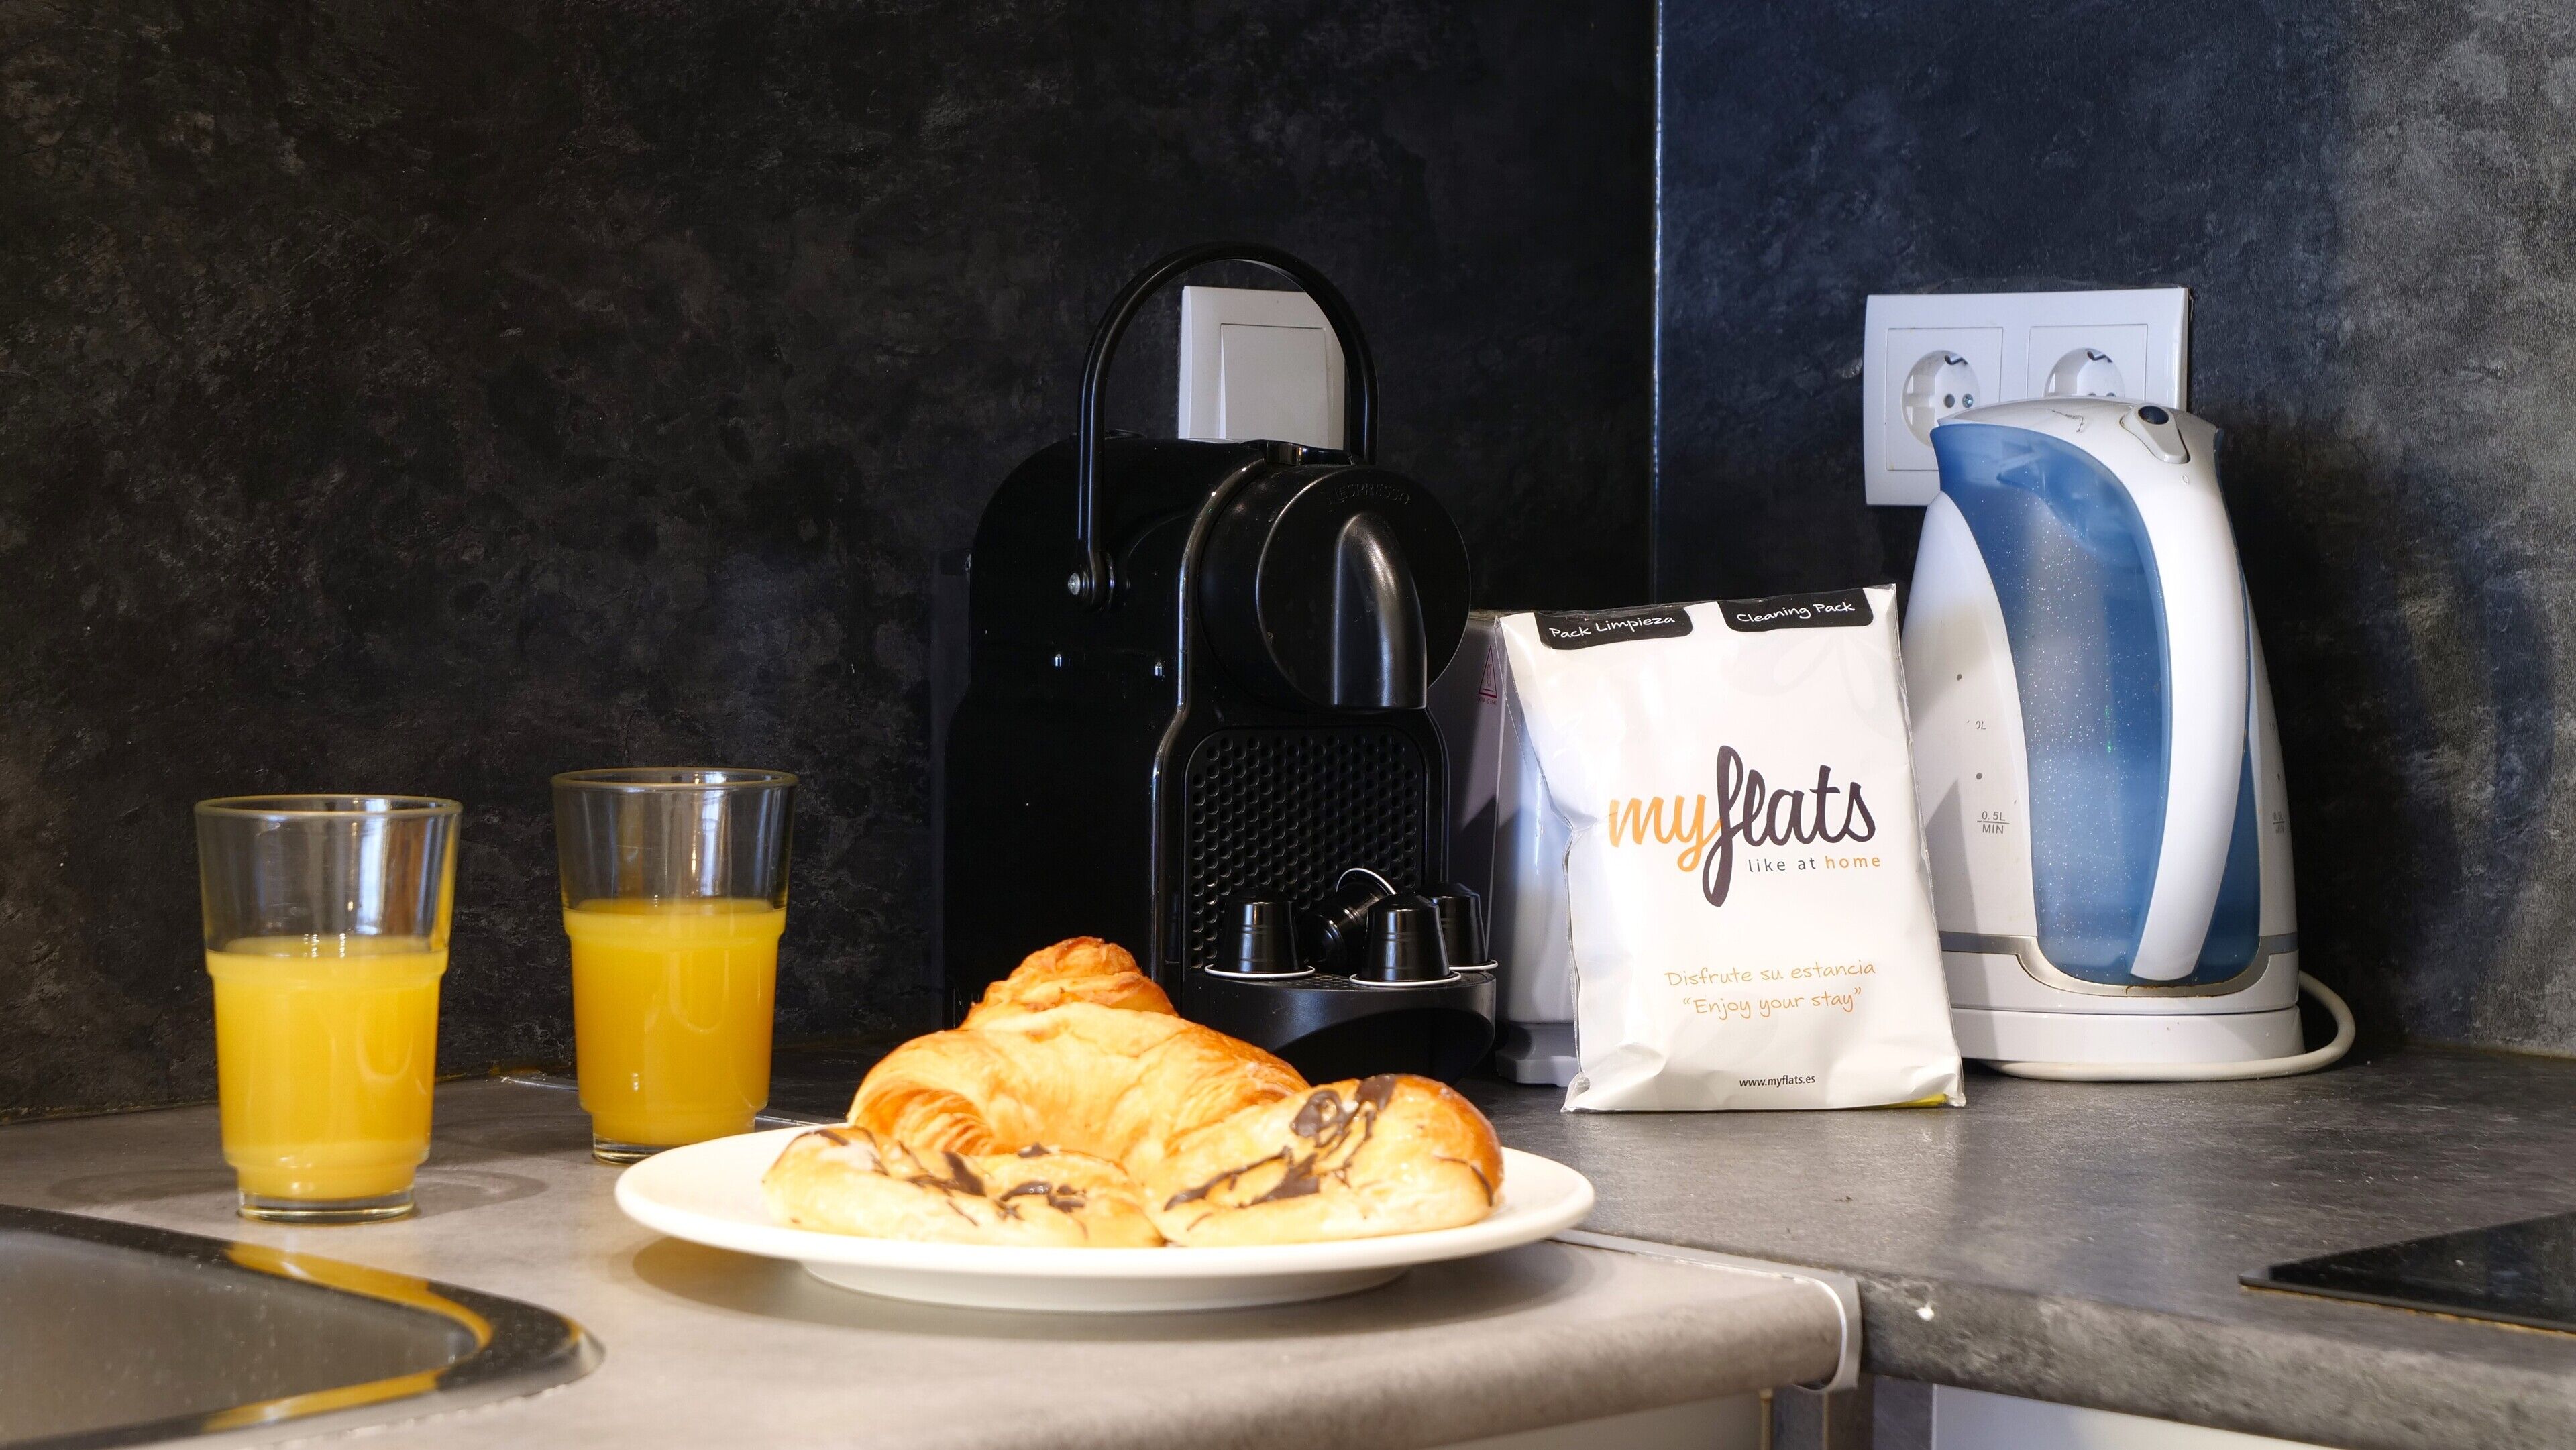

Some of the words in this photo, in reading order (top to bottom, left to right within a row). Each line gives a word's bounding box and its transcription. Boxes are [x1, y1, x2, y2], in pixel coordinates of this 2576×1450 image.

[1736, 606, 1811, 622] Cleaning
[1813, 601, 1856, 613] Pack
[1548, 626, 1591, 638] Pack
[1595, 616, 1676, 632] Limpieza
[1607, 745, 1876, 907] myflats
[1982, 810, 2006, 822] 0.5L
[1982, 824, 2004, 834] MIN
[1748, 858, 1786, 873] like
[1797, 857, 1817, 871] at
[1825, 855, 1881, 869] home
[1664, 966, 1754, 986] Disfrute
[1760, 968, 1784, 981] su
[1790, 960, 1876, 979] estancia
[1682, 997, 1752, 1021] “Enjoy
[1759, 996, 1805, 1018] your
[1811, 987, 1862, 1013] stay”
[1739, 1074, 1816, 1089] www.myflats.es
